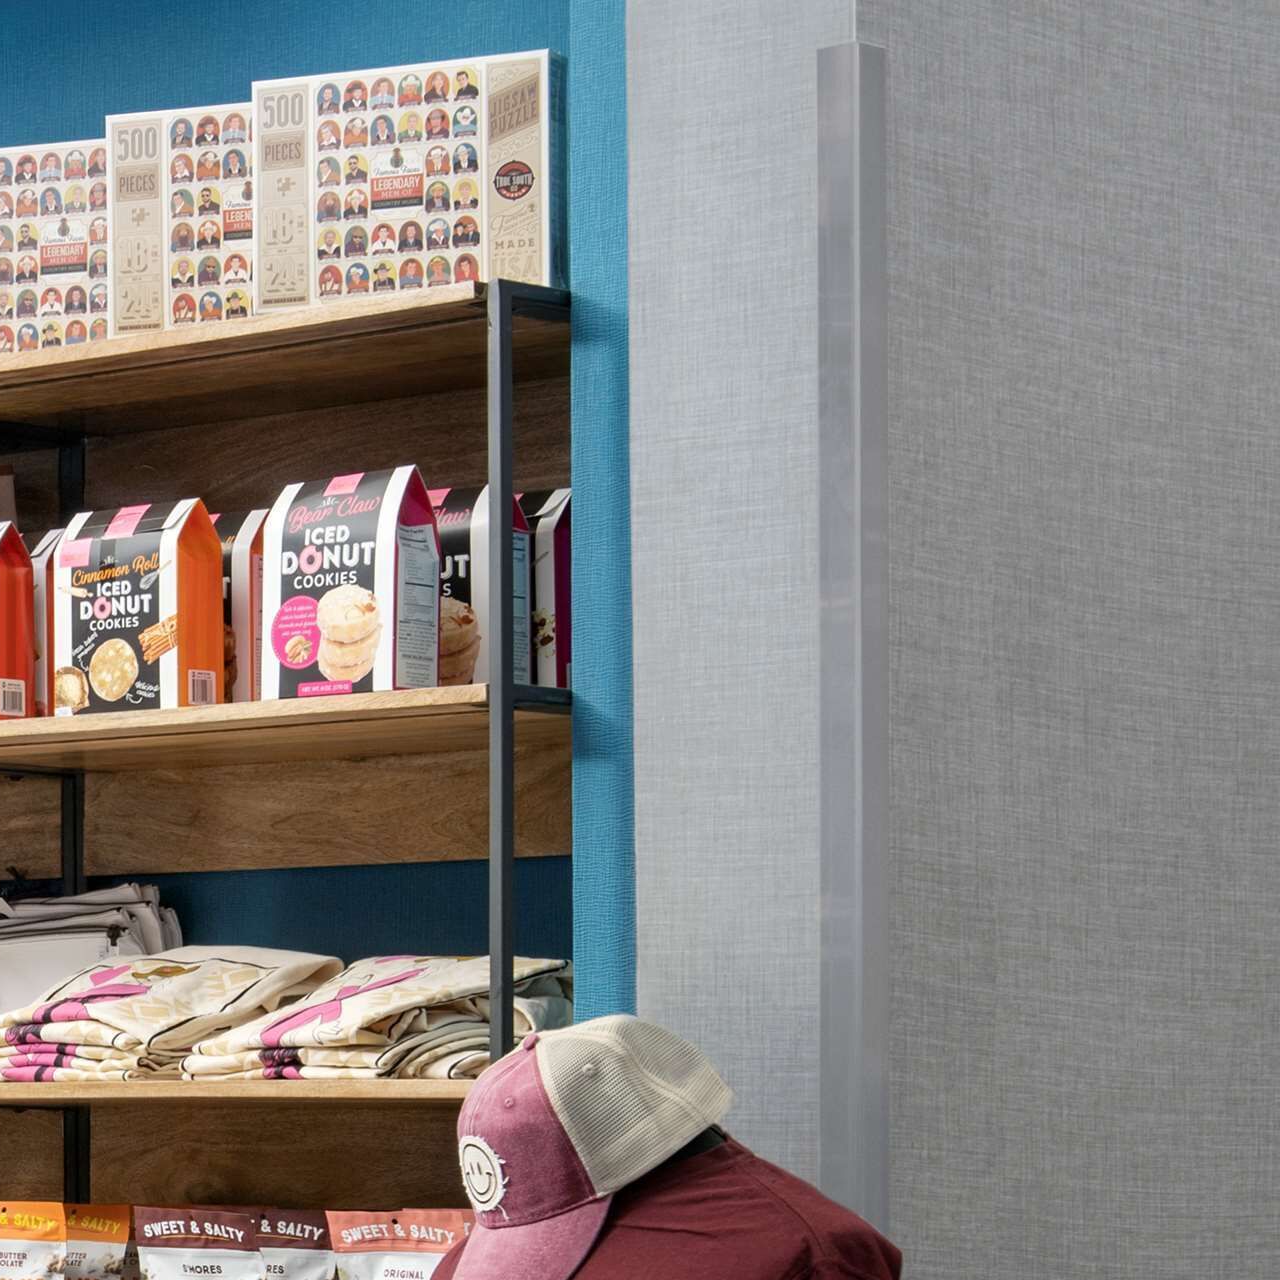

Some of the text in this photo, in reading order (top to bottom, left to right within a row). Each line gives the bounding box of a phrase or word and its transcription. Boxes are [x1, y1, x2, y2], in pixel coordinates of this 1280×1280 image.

[262, 93, 303, 128] 500
[117, 127, 157, 161] 500
[264, 142, 301, 162] PIECES
[119, 174, 155, 193] PIECES
[373, 175, 421, 191] LEGENDARY
[42, 245, 85, 259] LEGENDARY
[495, 239, 536, 251] MADE
[289, 496, 380, 533] Bear Claw
[305, 525, 350, 545] ICED
[281, 541, 375, 575] DONUT
[72, 552, 159, 587] Cinnamon Roll
[97, 580, 131, 596] ICED
[294, 571, 357, 590] COOKIES
[80, 594, 152, 620] DONUT
[90, 616, 139, 631] COOKIES
[0, 1213, 8, 1225] &
[13, 1214, 59, 1231] SALTY
[80, 1215, 121, 1234] SALTY
[144, 1220, 245, 1242] SWEET & SALTY
[261, 1220, 324, 1241] & SALTY
[342, 1224, 454, 1244] SWEET & SALTY
[384, 1269, 424, 1280] ORIGINAL
